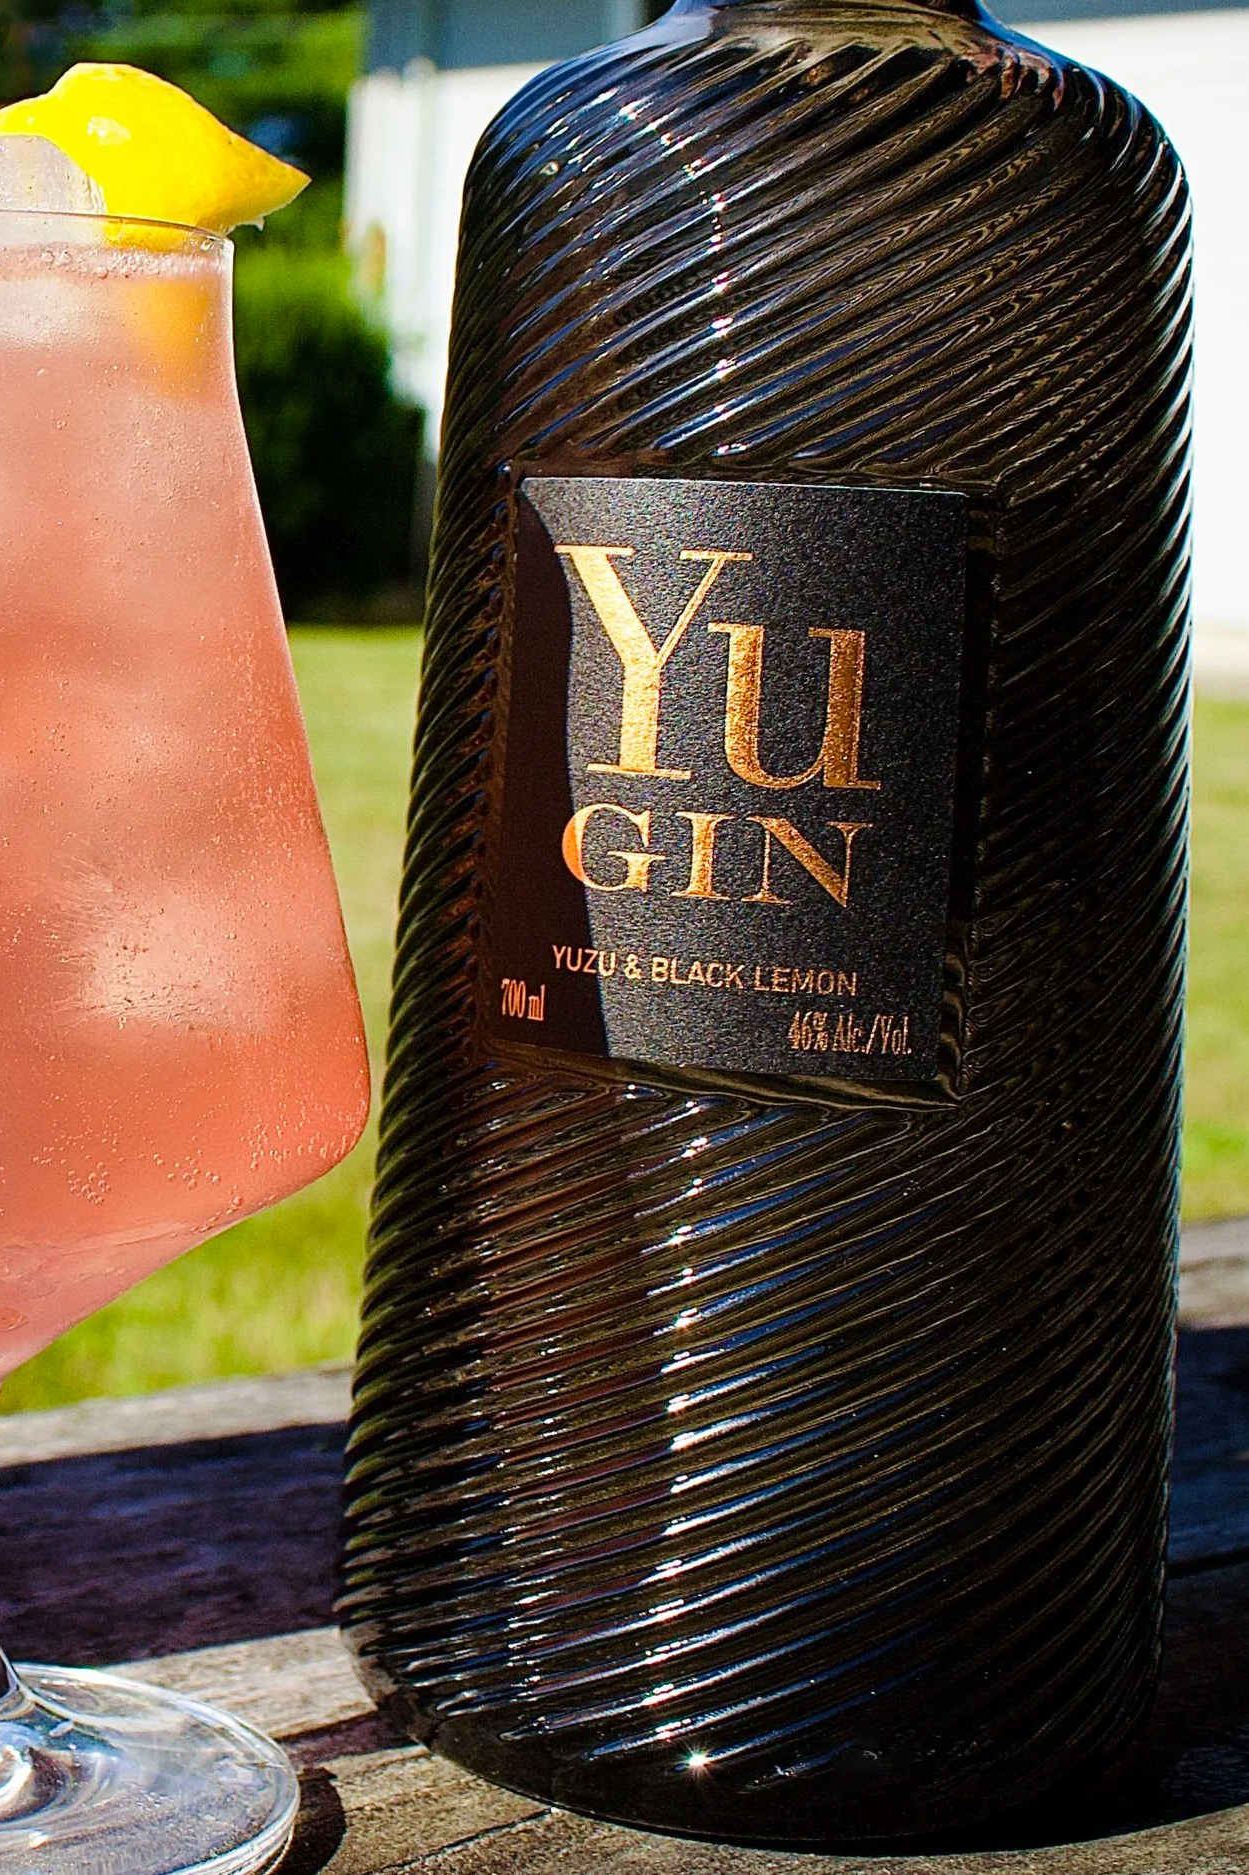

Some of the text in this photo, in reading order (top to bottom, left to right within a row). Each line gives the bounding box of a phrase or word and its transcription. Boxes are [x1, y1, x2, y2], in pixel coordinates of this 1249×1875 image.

[554, 543, 881, 792] Yu
[561, 803, 873, 908] GIN
[552, 944, 860, 997] YUZU & BLACK LEMON
[500, 978, 546, 1022] 700 ml
[786, 1010, 829, 1052] 46%
